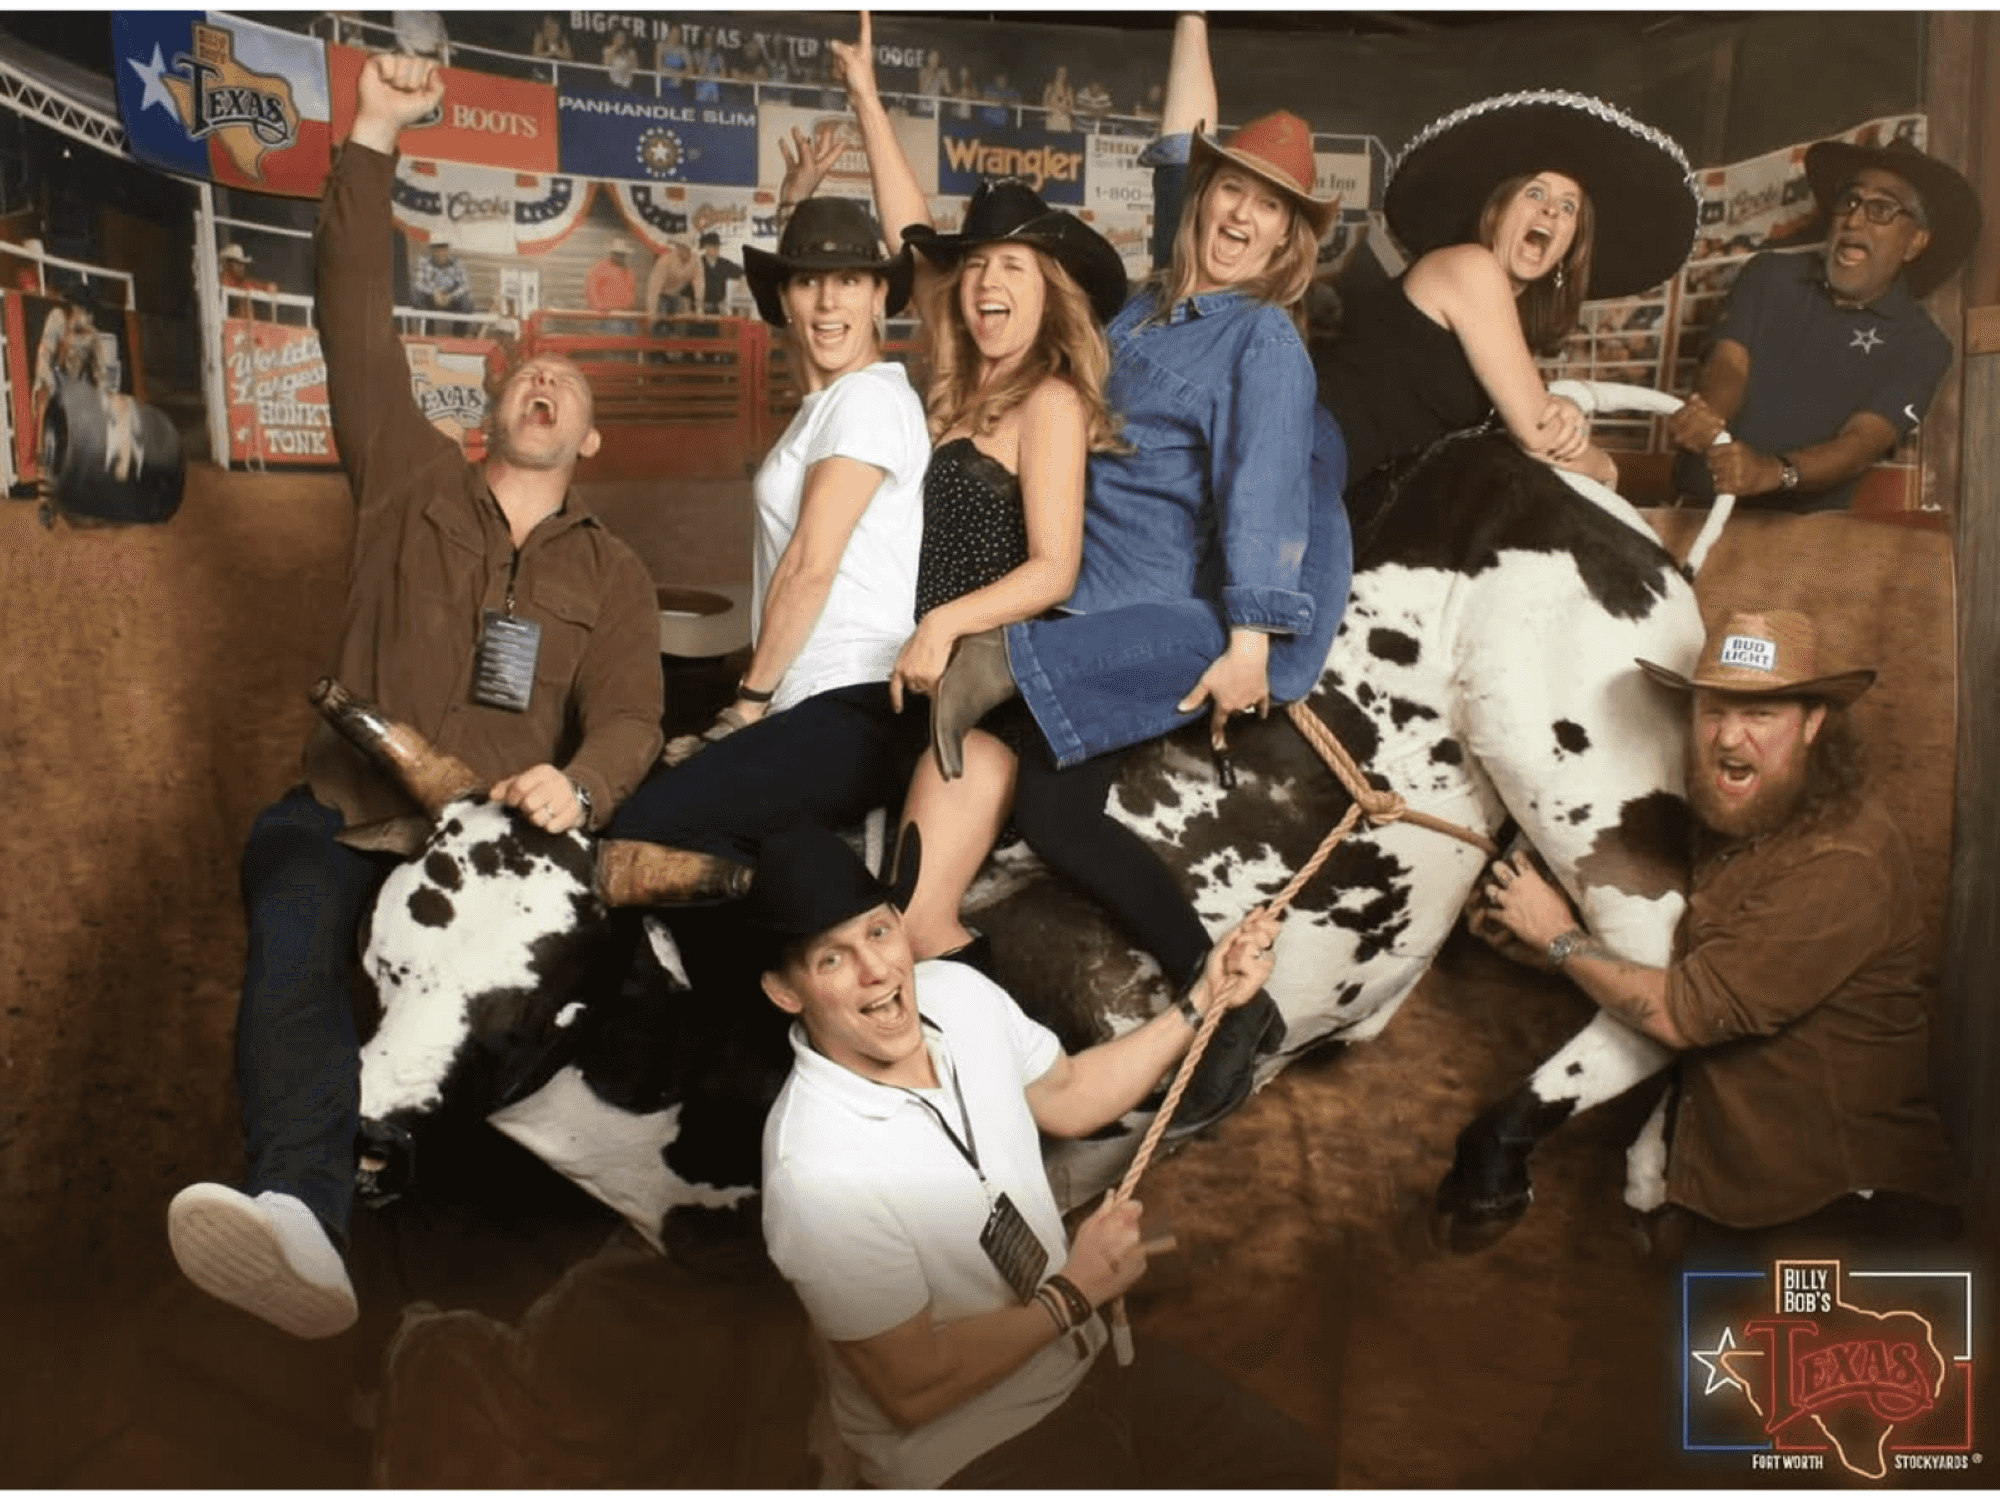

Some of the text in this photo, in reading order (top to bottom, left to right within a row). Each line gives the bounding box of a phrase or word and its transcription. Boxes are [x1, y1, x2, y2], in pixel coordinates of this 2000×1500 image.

[174, 57, 290, 144] TEXAS
[558, 95, 757, 127] PANHANDLE SLIM
[453, 104, 538, 138] BOOTS
[942, 134, 1084, 192] Wrangler
[265, 429, 329, 454] TONK
[1725, 651, 1769, 665] LIGHT
[1733, 639, 1765, 652] BUD
